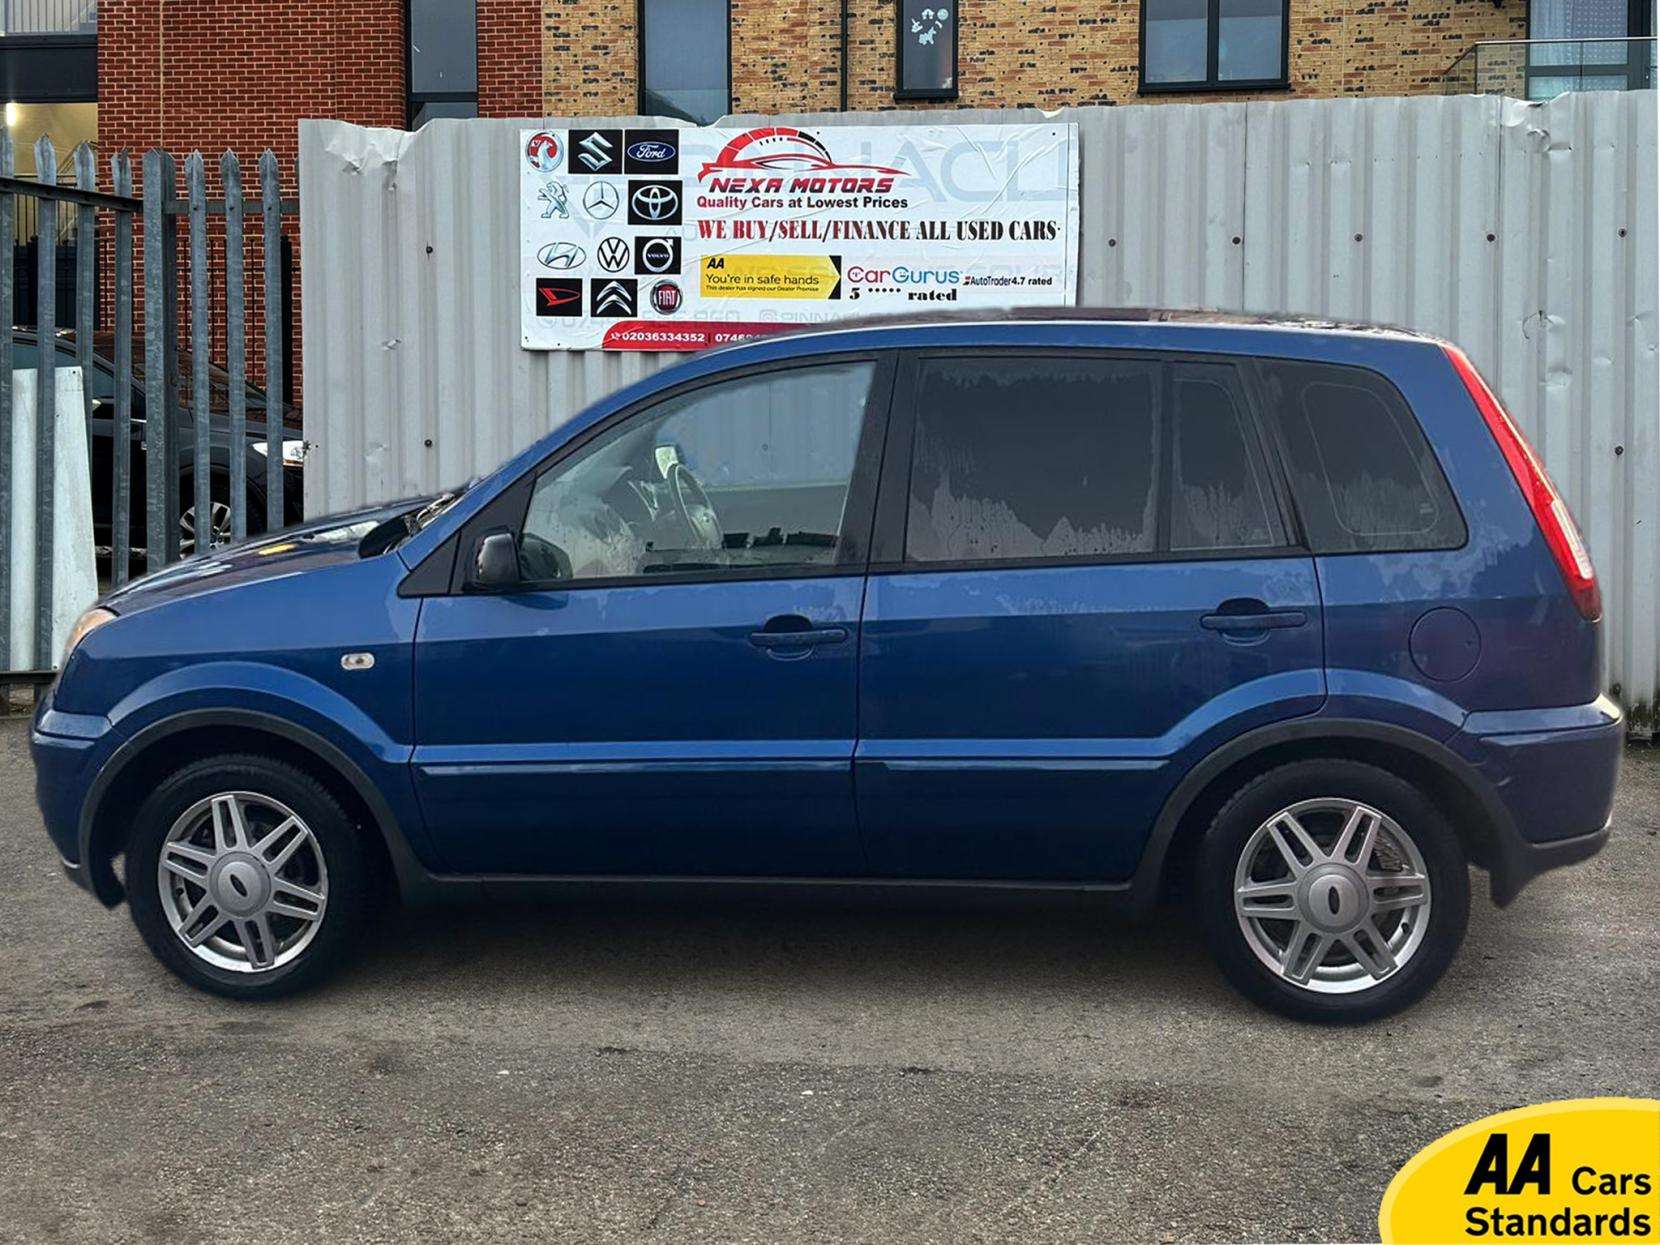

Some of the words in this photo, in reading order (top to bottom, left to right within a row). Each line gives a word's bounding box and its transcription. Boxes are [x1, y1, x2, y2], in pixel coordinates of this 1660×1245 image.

[636, 144, 666, 159] Ford
[709, 177, 783, 194] NEXA
[789, 177, 894, 194] MOTORS
[697, 196, 747, 210] Quality
[752, 196, 784, 209] Cars
[788, 196, 803, 208] at
[807, 196, 859, 209] Lowest
[863, 196, 909, 209] Prices
[697, 220, 727, 240] WE
[916, 220, 951, 240] ALL
[956, 220, 1004, 240] USED
[1008, 220, 1057, 240] CARS
[707, 257, 725, 269] AA
[706, 274, 741, 284] You're
[744, 274, 755, 284] in
[757, 274, 781, 285] safe
[784, 274, 820, 285] hands
[847, 266, 960, 284] CarGurus
[1028, 276, 1053, 286] rated
[658, 290, 676, 305] FIAT
[849, 287, 861, 300] 5
[908, 288, 958, 301] rated
[622, 333, 705, 342] 02036334352
